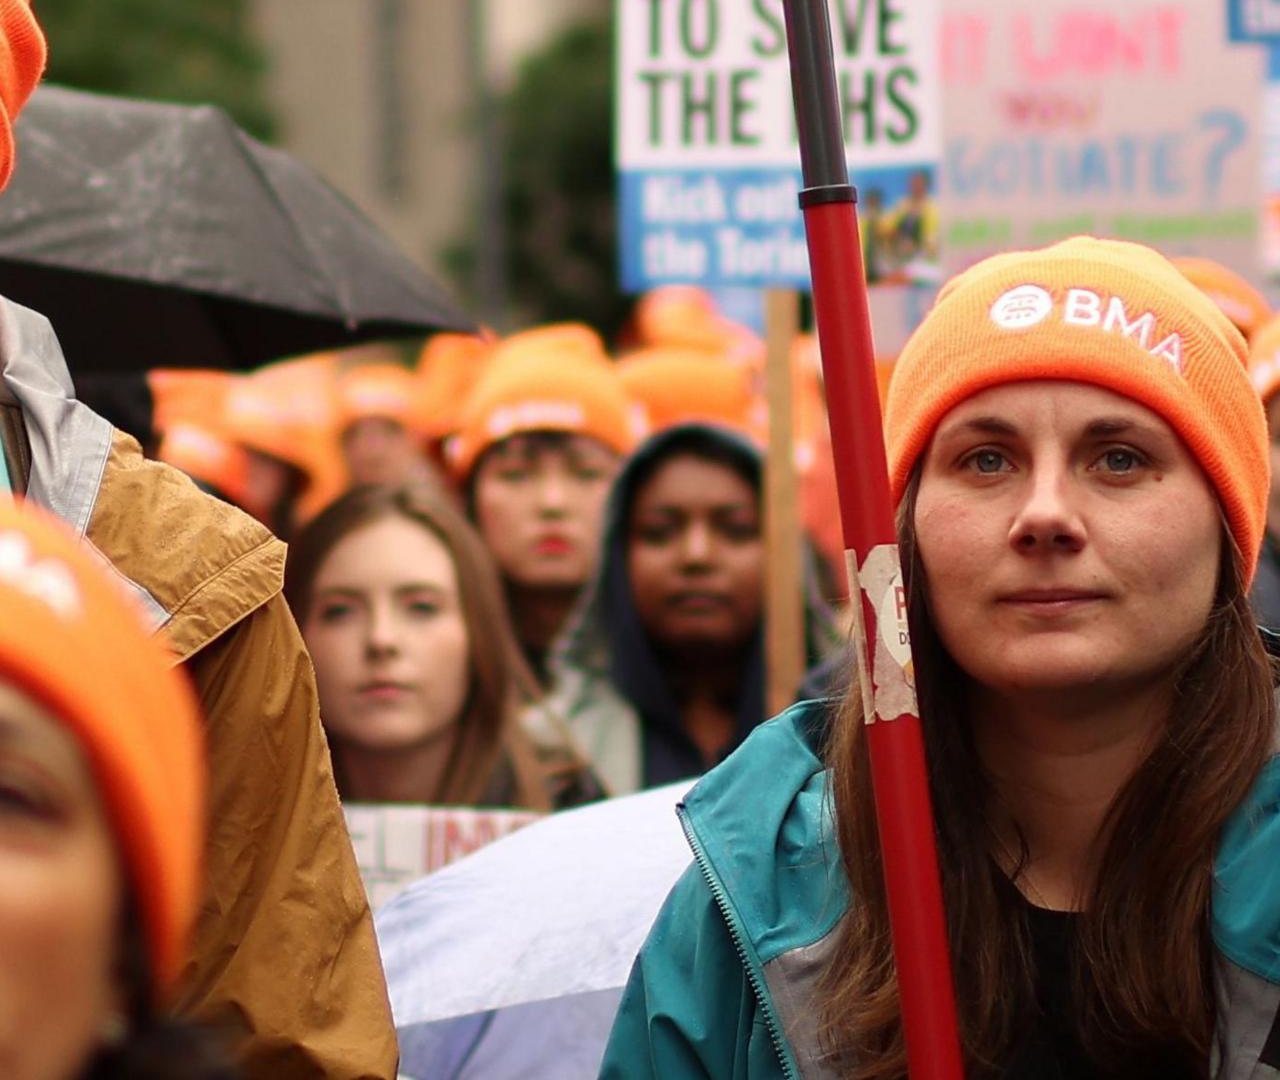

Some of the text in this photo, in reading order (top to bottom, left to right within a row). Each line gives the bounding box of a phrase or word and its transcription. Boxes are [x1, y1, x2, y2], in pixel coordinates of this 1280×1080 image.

[638, 68, 919, 147] THE HS
[1063, 288, 1183, 370] BMA
